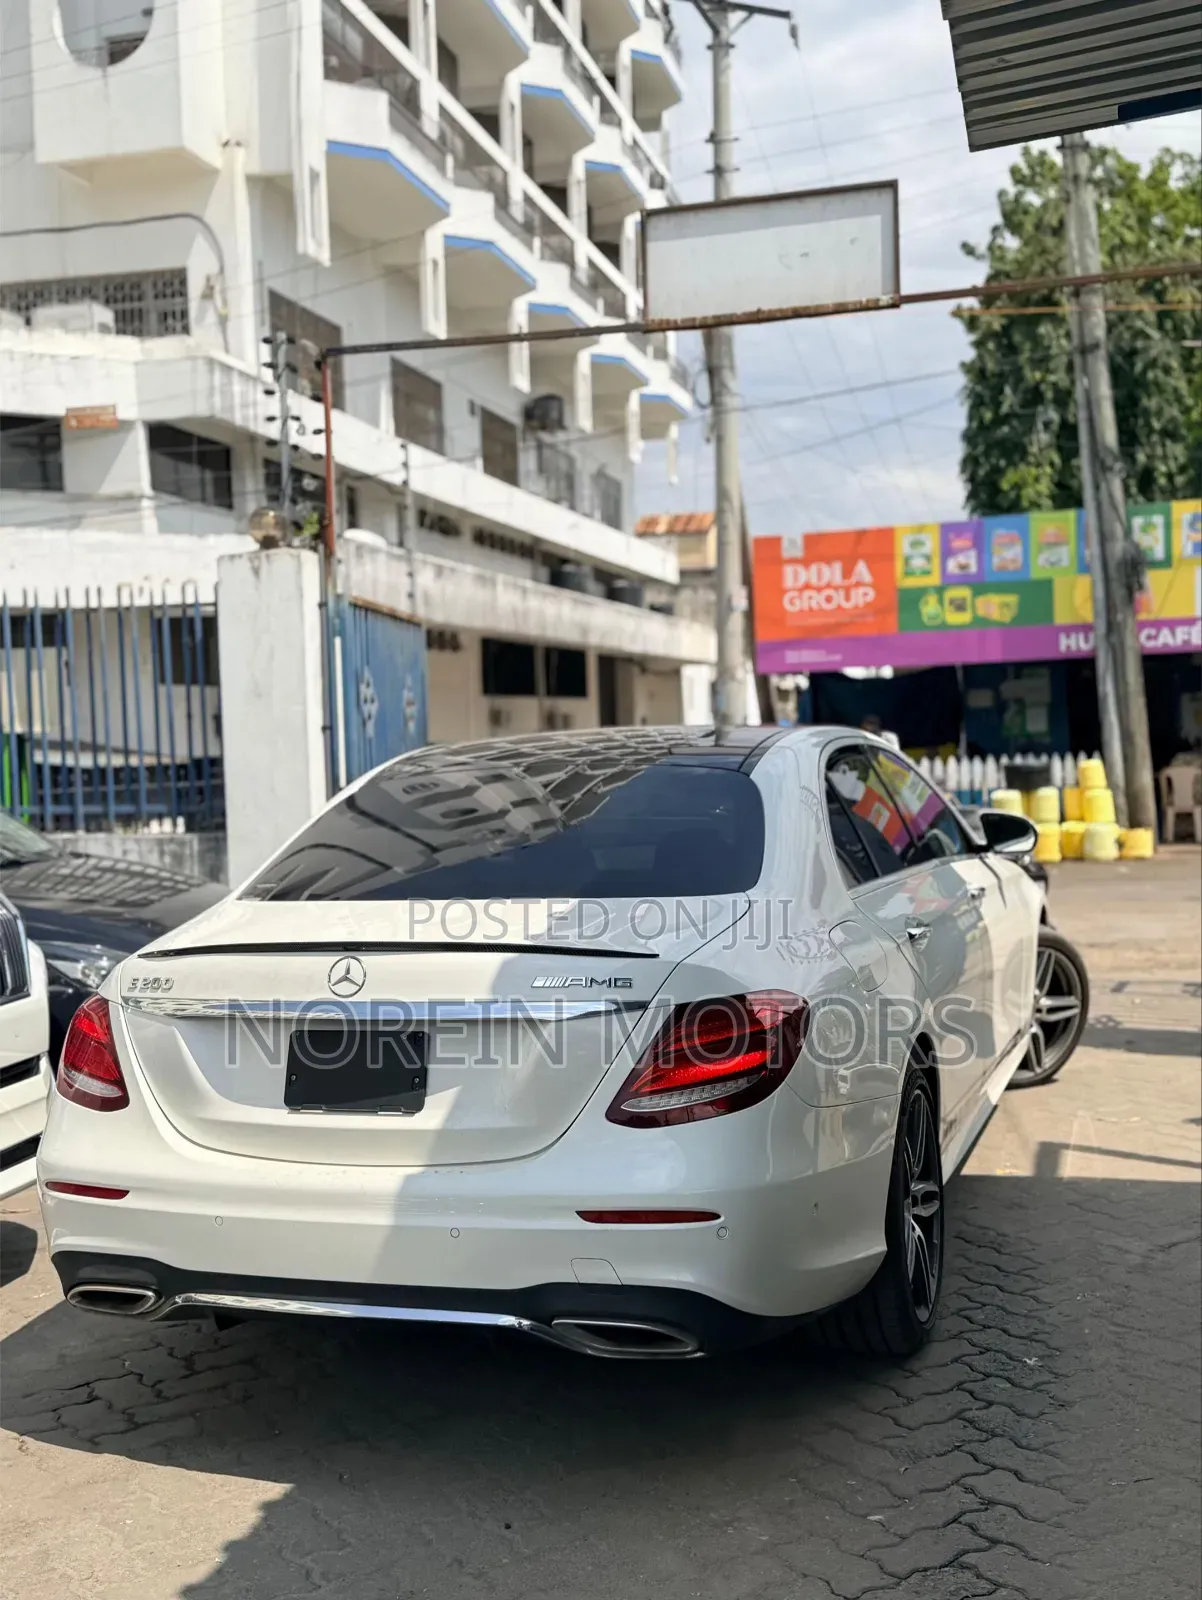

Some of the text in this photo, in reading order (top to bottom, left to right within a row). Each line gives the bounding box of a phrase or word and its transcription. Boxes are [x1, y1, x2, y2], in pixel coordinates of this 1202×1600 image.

[782, 559, 873, 589] DOLA
[782, 585, 876, 613] GROUP
[1058, 620, 1202, 653] HU CAFÉ
[562, 976, 634, 989] AMG
